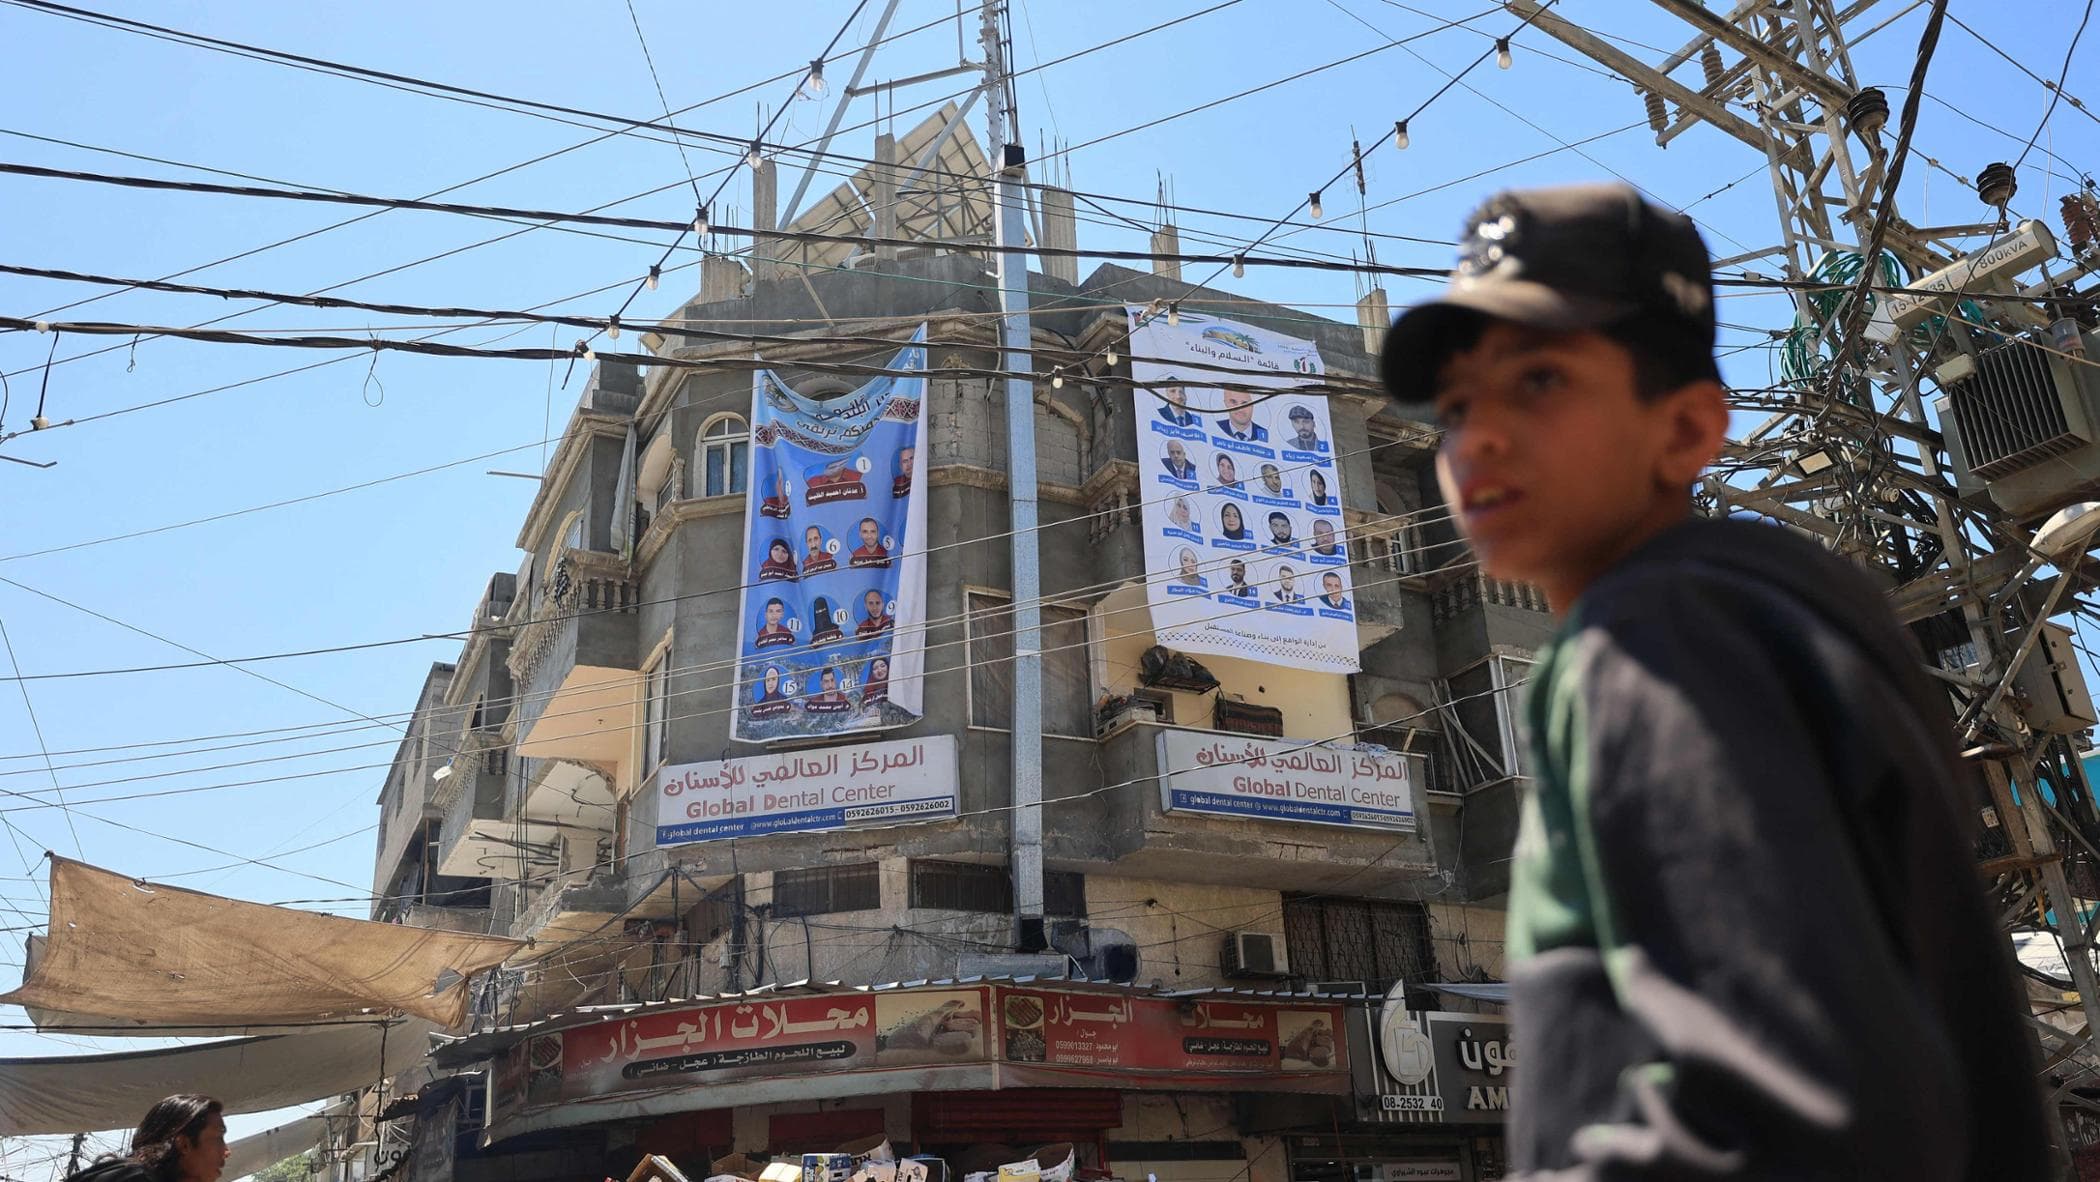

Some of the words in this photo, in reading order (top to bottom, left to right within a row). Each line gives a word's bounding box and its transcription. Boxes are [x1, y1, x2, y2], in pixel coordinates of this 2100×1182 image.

[1979, 239, 2027, 269] 800kVA
[828, 541, 837, 552] 6
[836, 611, 847, 622] 10
[888, 602, 895, 614] 9
[790, 620, 800, 631] 11
[784, 682, 796, 694] 15
[851, 745, 924, 777] المركز
[1196, 742, 1267, 768] للأسنان
[1271, 751, 1342, 774] العالمي
[663, 761, 746, 796] للأسنان
[751, 754, 838, 787] العالمي
[1351, 755, 1409, 781] المركز
[686, 797, 755, 819] Global
[763, 788, 824, 810] Dental
[831, 782, 896, 803] Center
[1190, 795, 1211, 805] global
[1212, 797, 1232, 807] dental
[1233, 801, 1253, 809] center
[1233, 775, 1291, 797] Global
[1296, 782, 1346, 802] Dental
[1351, 787, 1400, 808] Center
[900, 800, 949, 812] 0592626002
[669, 829, 692, 839] global
[693, 826, 718, 835] dental
[719, 823, 744, 833] center
[732, 1003, 869, 1040] محلات
[1050, 996, 1134, 1031] الجزار
[1182, 1003, 1264, 1029] محلات
[602, 1004, 722, 1064] الجزار
[718, 1052, 772, 1065] الطازجة
[774, 1048, 814, 1061] اللحوم
[817, 1044, 846, 1057] لبيع
[1384, 1097, 1425, 1109] 08-2532
[1468, 1086, 1511, 1110] AM
